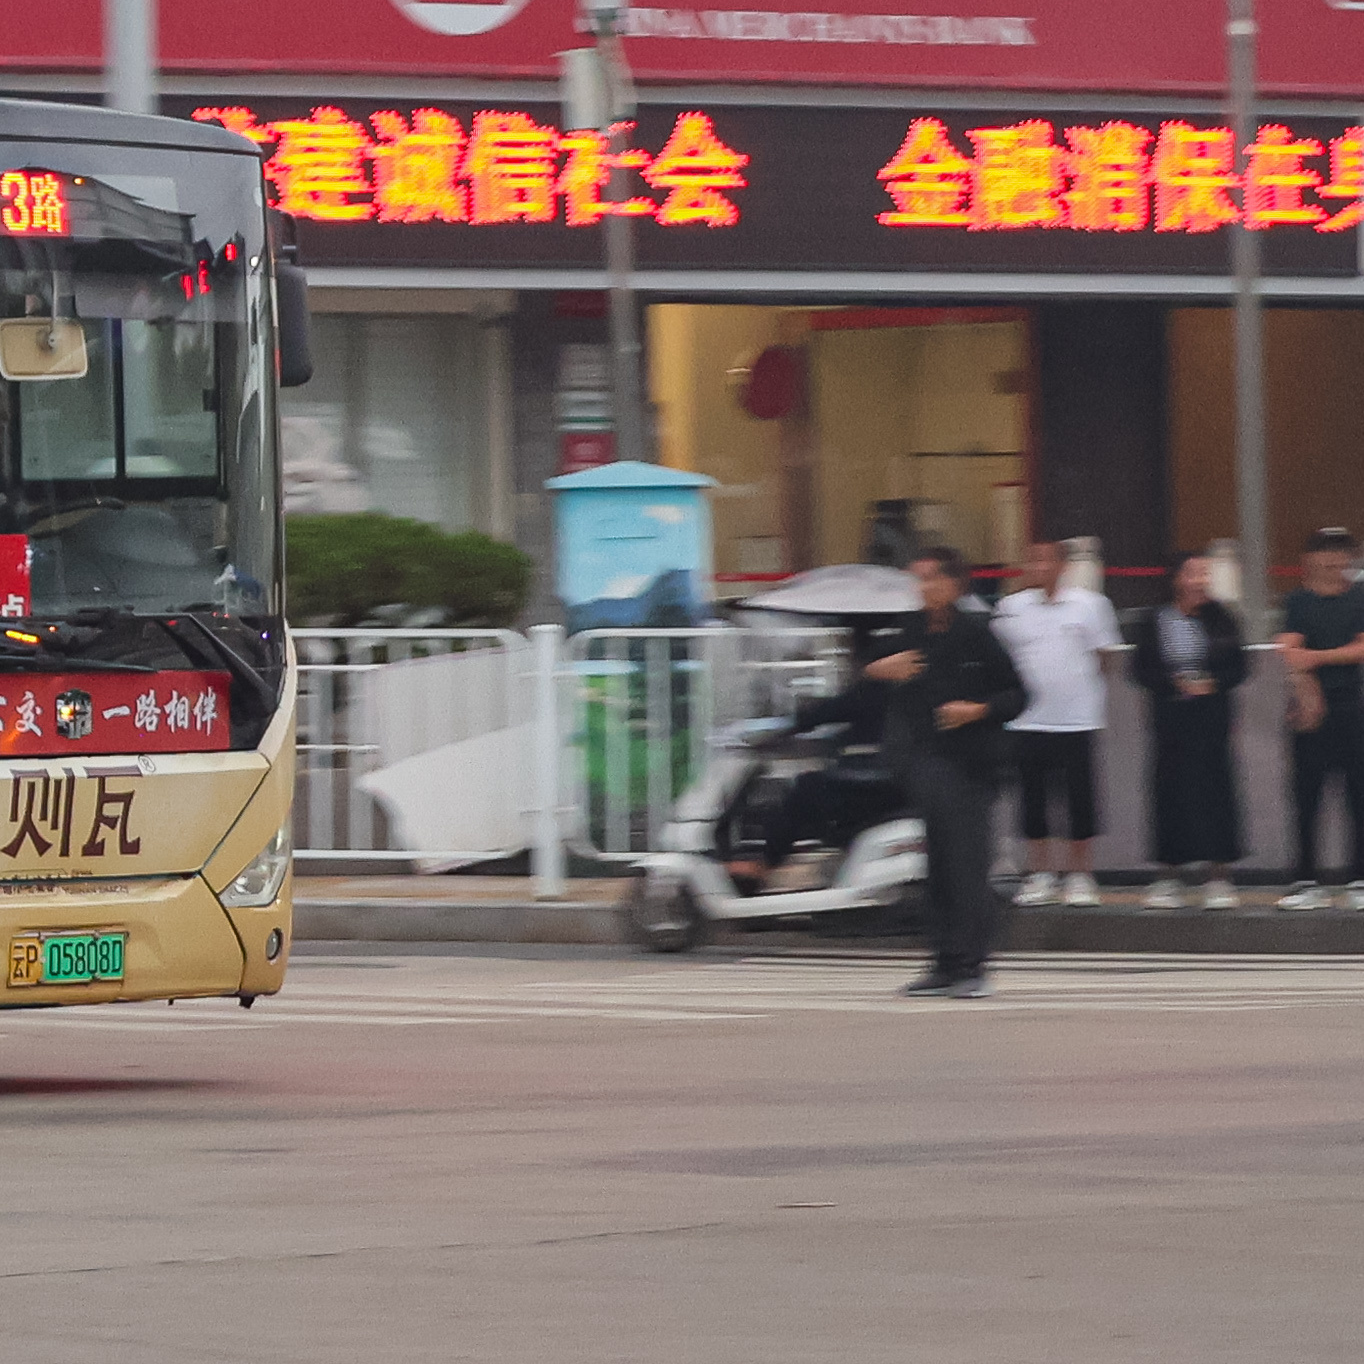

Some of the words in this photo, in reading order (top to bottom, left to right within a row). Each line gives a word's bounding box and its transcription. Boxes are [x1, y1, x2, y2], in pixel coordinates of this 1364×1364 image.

[0, 171, 65, 233] 3路
[190, 105, 751, 227] 建诚信社会
[100, 686, 220, 737] 一路相伴
[0, 766, 144, 859] 则瓦
